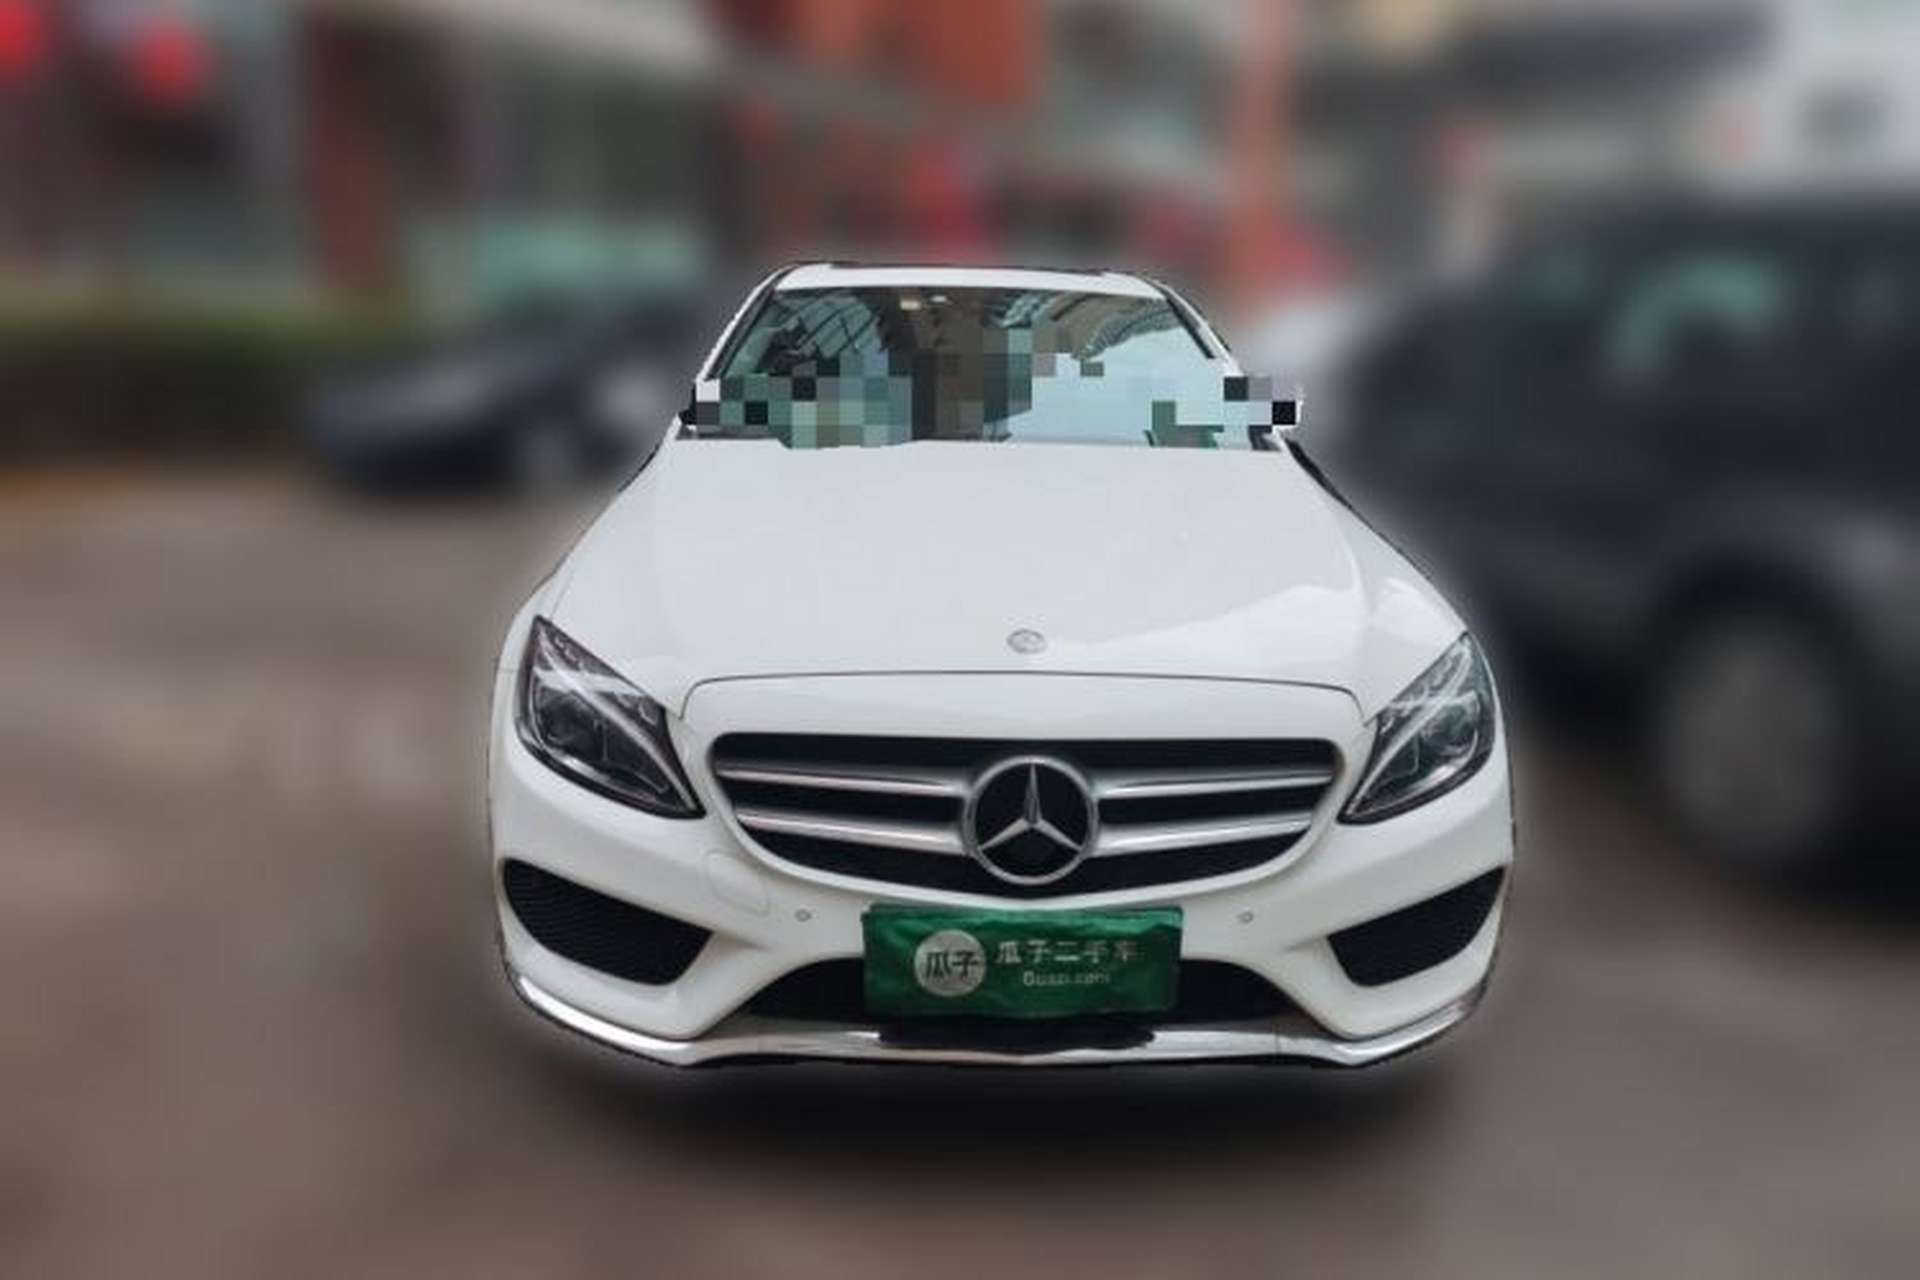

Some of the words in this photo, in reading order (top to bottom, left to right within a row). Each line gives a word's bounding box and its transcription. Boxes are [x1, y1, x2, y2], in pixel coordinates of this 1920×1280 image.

[925, 950, 980, 980] 瓜子
[995, 938, 1139, 964] 瓜子二手车
